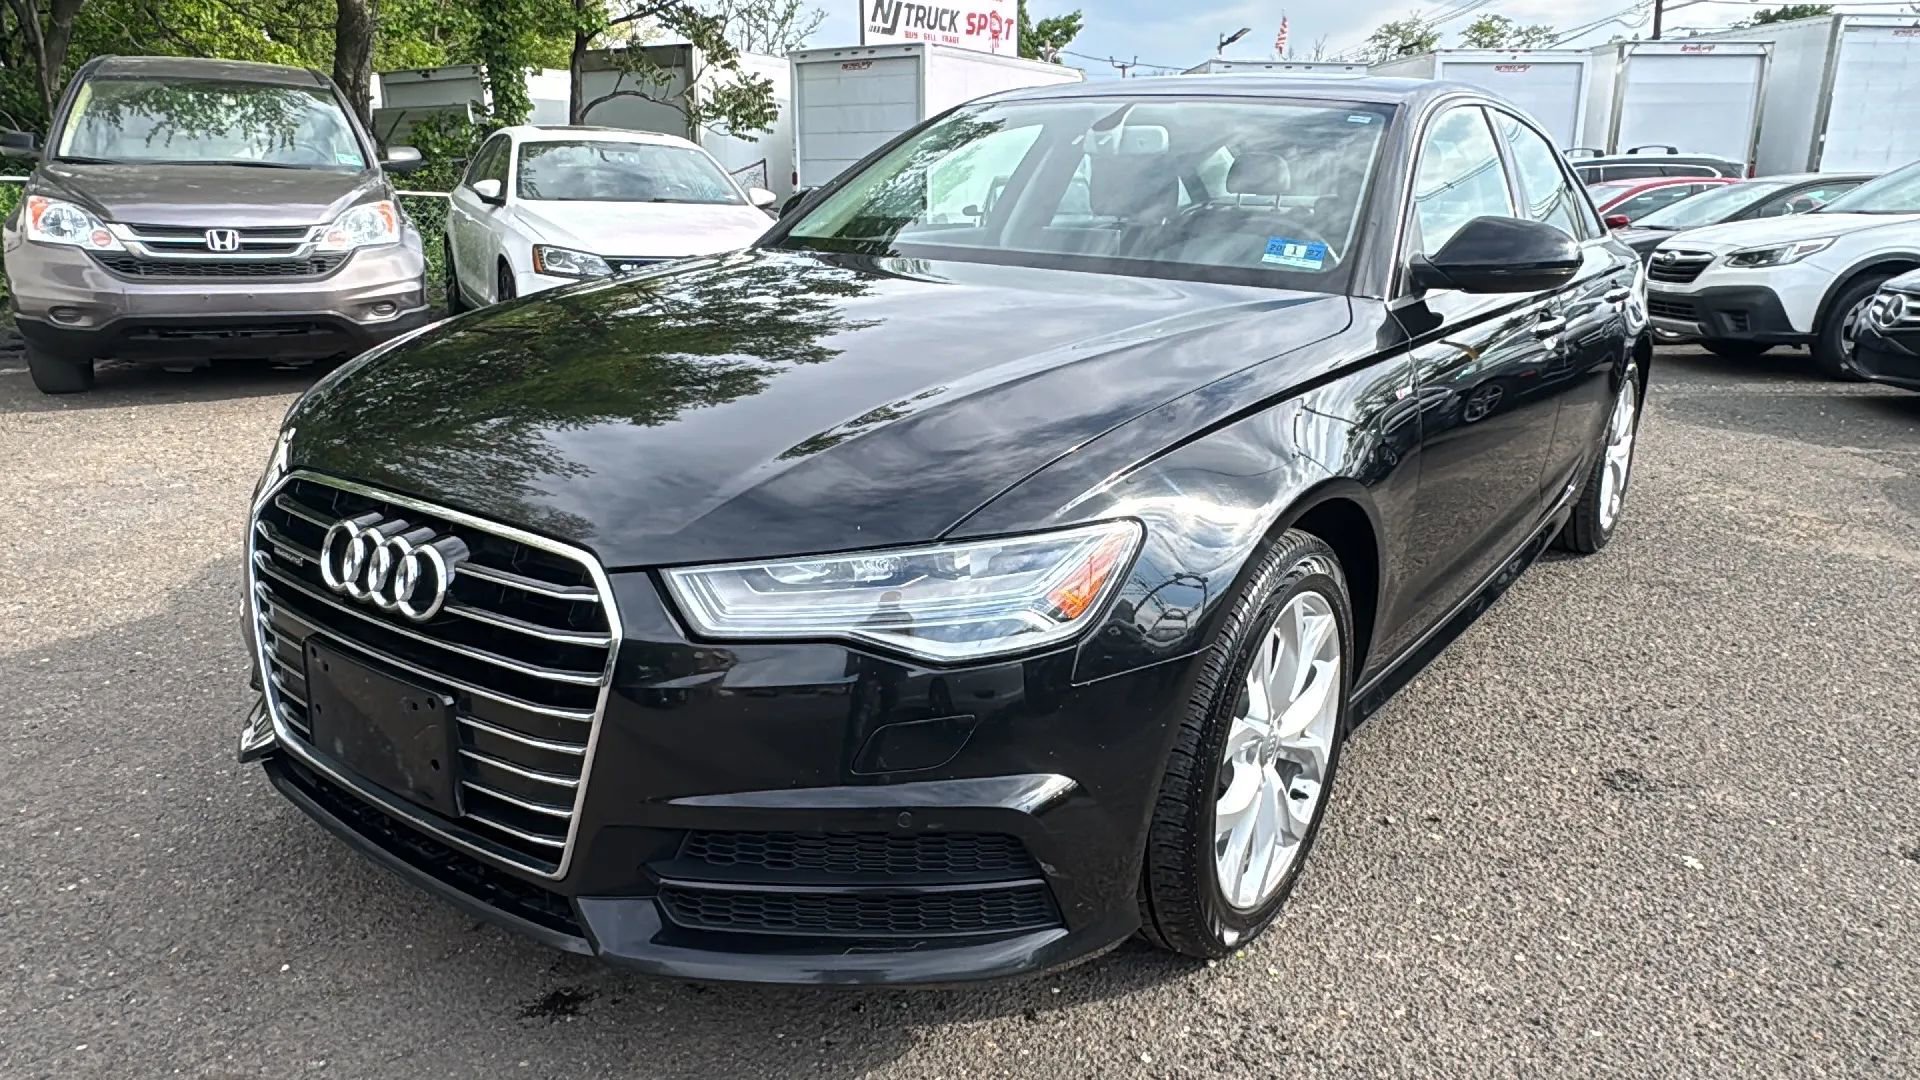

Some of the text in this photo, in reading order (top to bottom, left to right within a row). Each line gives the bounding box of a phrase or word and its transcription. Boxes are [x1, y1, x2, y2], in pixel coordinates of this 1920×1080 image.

[872, 0, 1015, 41] NJ TRUCK SPOT
